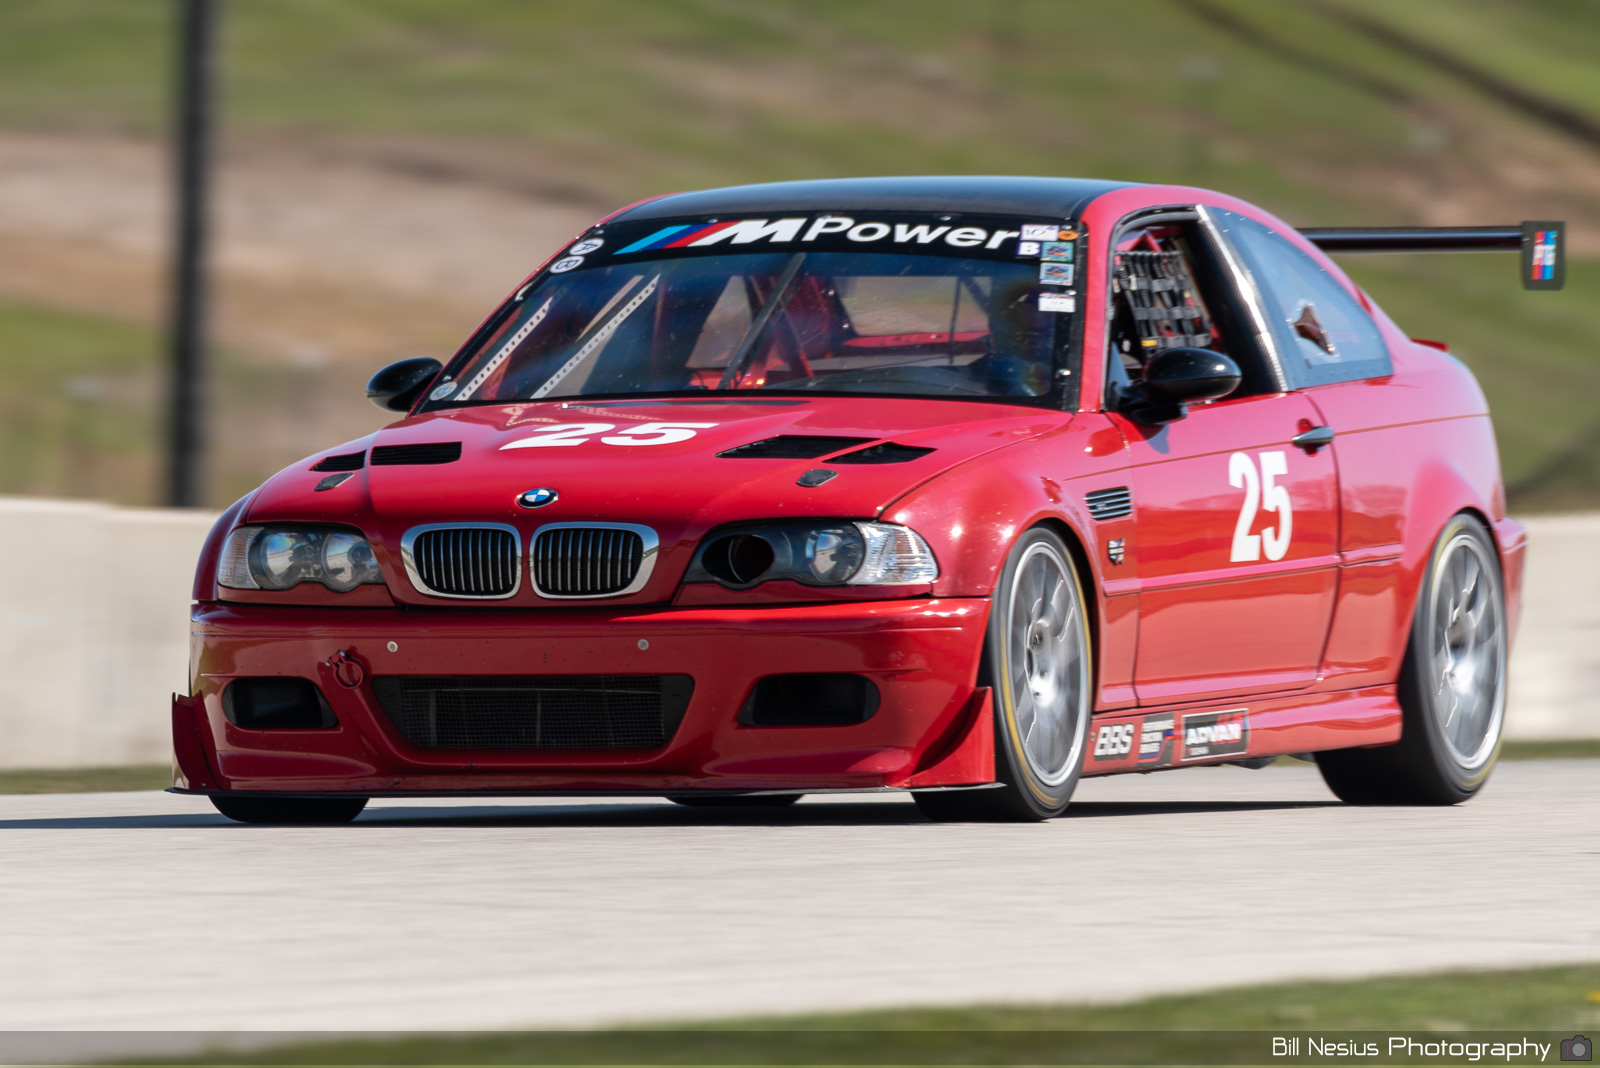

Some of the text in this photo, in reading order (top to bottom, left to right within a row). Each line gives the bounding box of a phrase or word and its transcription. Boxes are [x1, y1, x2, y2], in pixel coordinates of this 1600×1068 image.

[801, 216, 1021, 250] Power
[1018, 241, 1041, 256] B
[499, 422, 720, 450] 25
[1228, 451, 1293, 562] 25
[1094, 723, 1135, 757] BBS
[1185, 723, 1241, 745] ADVAN
